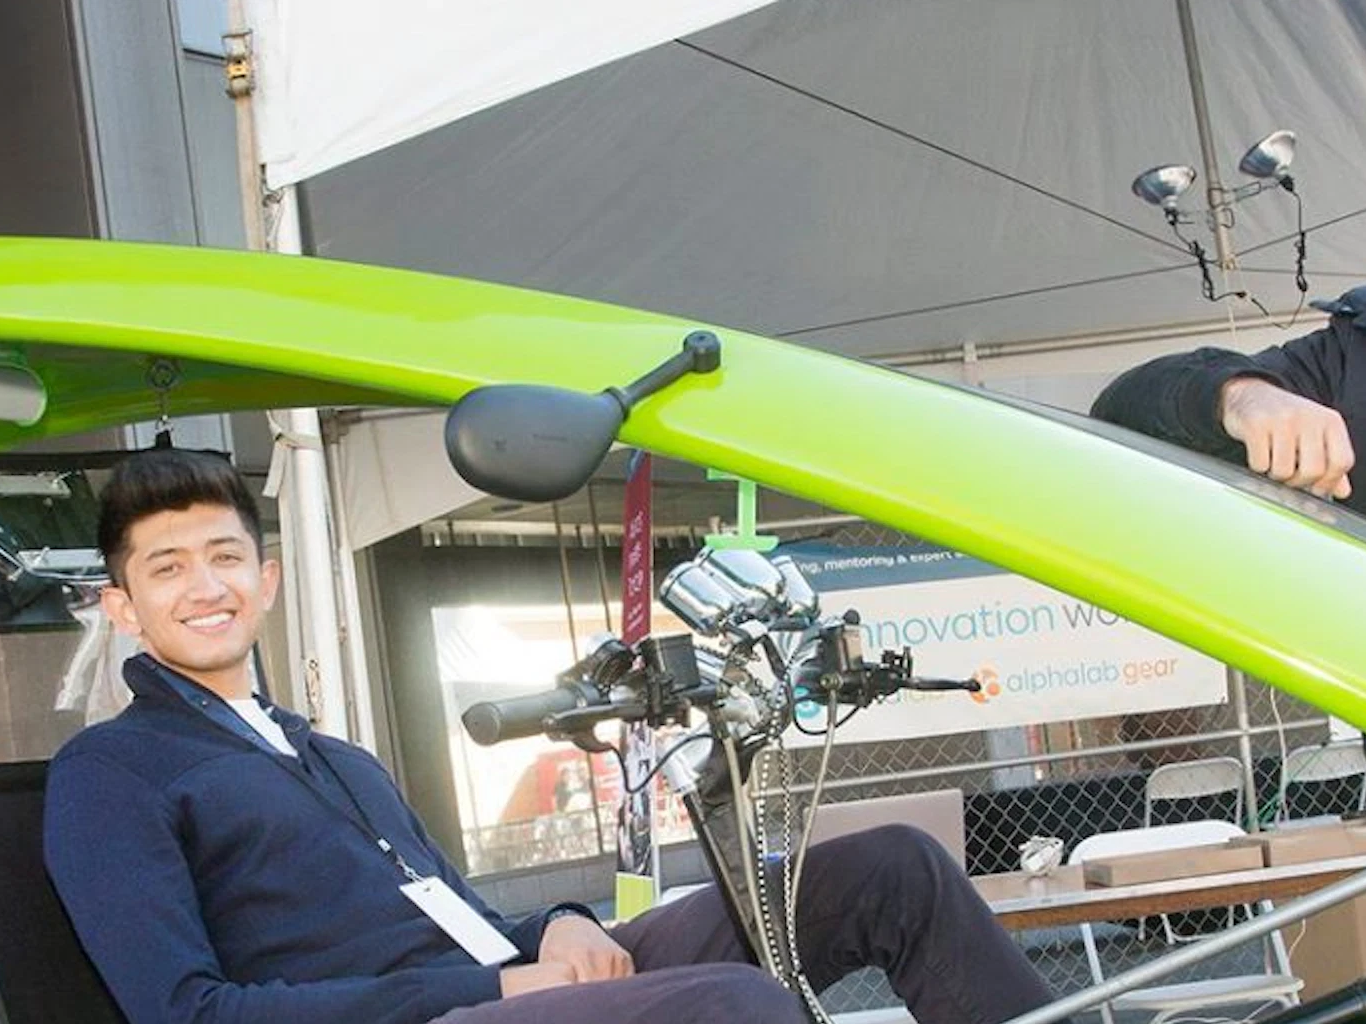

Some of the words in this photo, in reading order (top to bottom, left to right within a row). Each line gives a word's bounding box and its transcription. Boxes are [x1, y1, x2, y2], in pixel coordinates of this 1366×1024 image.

[824, 555, 894, 571] mentoring
[896, 554, 908, 564] &
[862, 601, 1054, 649] nnovation
[1006, 660, 1119, 694] alphalab
[1122, 656, 1179, 685] gear
